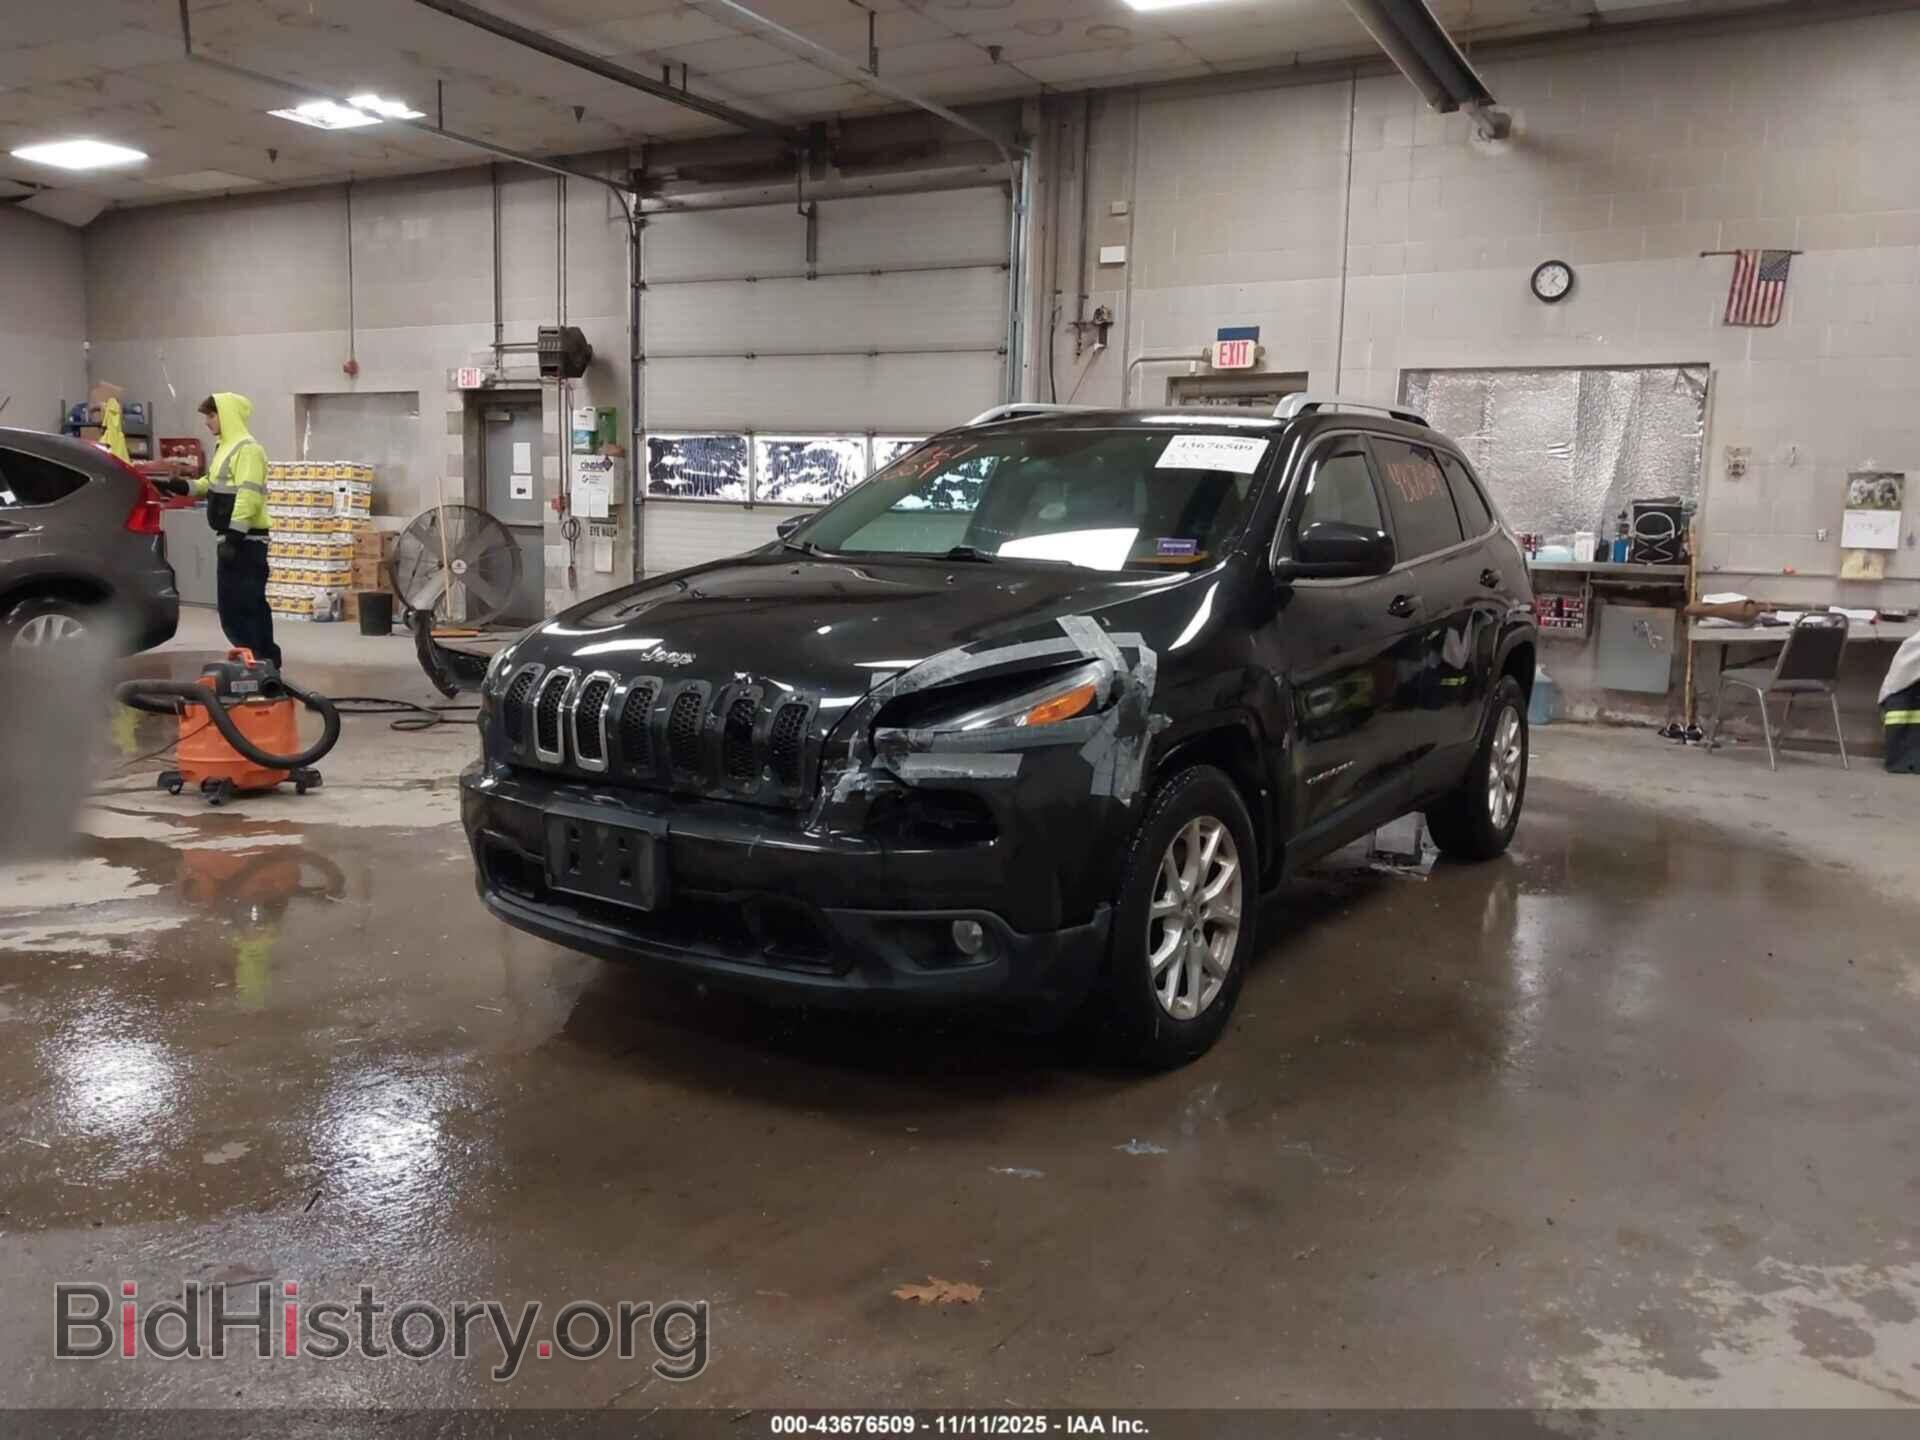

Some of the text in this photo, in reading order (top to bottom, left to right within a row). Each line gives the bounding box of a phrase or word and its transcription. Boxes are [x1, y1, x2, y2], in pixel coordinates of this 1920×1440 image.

[1219, 342, 1249, 366] EXIT
[461, 368, 478, 386] EXIT
[641, 646, 693, 667] Jeep
